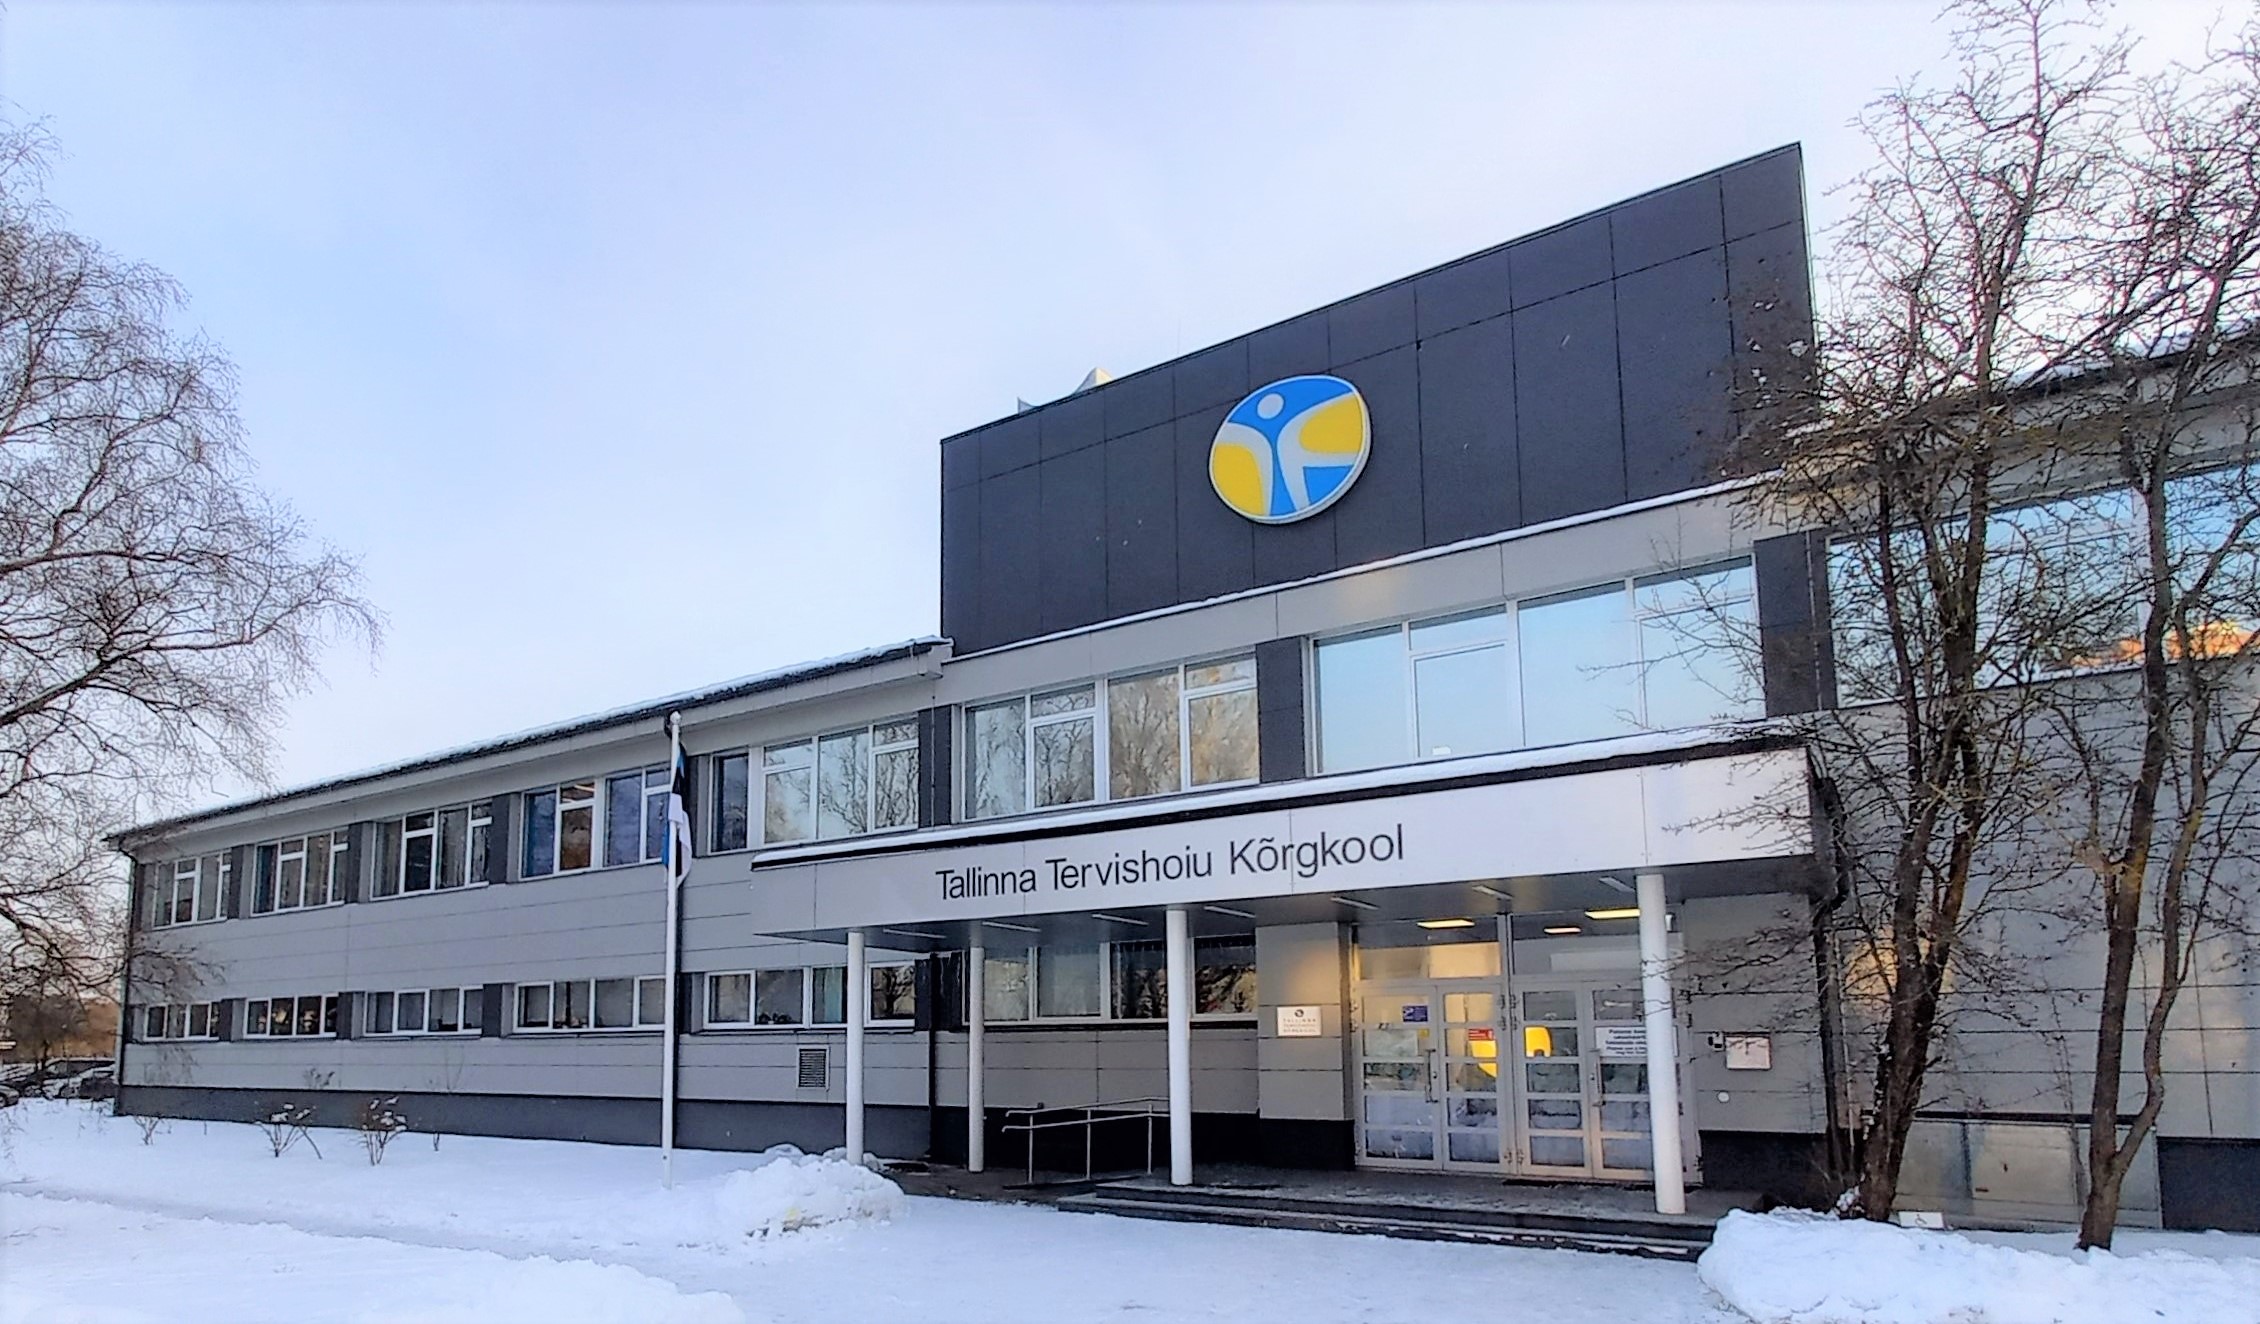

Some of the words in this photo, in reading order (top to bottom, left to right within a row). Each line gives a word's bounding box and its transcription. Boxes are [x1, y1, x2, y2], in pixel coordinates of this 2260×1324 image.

[935, 866, 1037, 900] Tallinna
[1045, 846, 1212, 890] Tervishoiu
[1230, 824, 1403, 879] Kõrgkool
